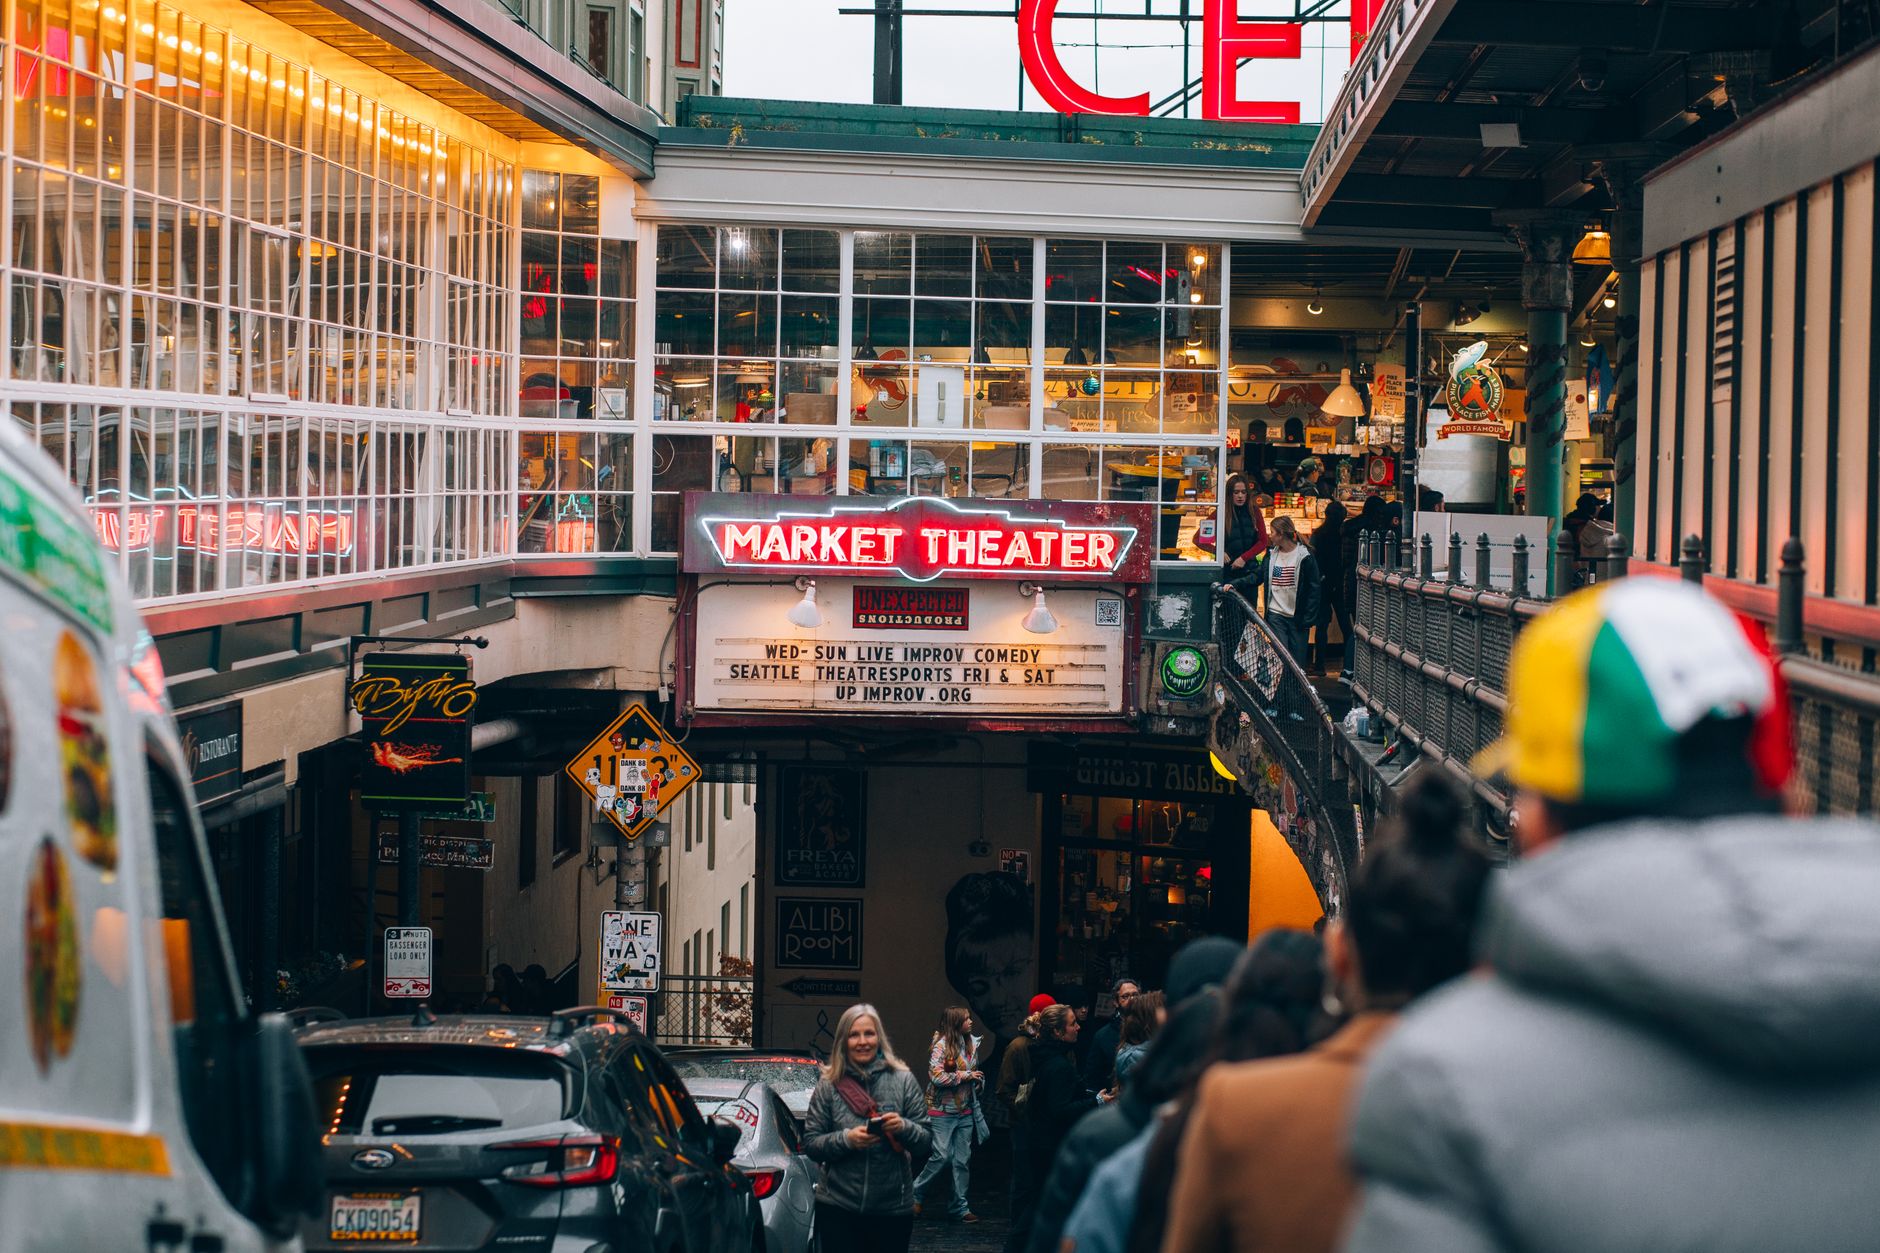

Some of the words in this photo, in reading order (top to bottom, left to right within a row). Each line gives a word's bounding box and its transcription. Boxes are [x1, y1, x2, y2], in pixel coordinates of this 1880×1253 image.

[1017, 0, 1385, 121] CE
[1453, 403, 1473, 419] PLACE
[1475, 408, 1492, 418] FISH
[1490, 378, 1501, 409] MARKET
[1473, 424, 1504, 432] FAMOUS
[724, 524, 903, 563] MARKET
[920, 527, 1115, 569] THEATER
[858, 590, 964, 612] UNEXPECTED
[858, 614, 963, 625] PRODUCTIONS
[815, 646, 847, 662] SUN
[857, 647, 894, 662] LIVE
[903, 647, 964, 663] IMPROV
[974, 648, 1040, 664] COMEDY
[729, 663, 800, 681] SEATTLE
[816, 666, 953, 683] THEATRESPORTS
[963, 667, 990, 683] FRI
[999, 668, 1009, 683] &
[1023, 669, 1055, 684] SAT
[835, 686, 859, 701] UP
[349, 672, 477, 736] Bistro
[199, 733, 238, 763] RISTORANTE
[1077, 757, 1156, 788] GHOST
[787, 849, 856, 863] FREYA
[1002, 850, 1015, 860] NO
[814, 863, 856, 872] BAKERY
[788, 906, 852, 932] ALIBI
[389, 941, 427, 950] PASSENGER
[389, 951, 407, 960] LOAD
[409, 951, 426, 960] ONLY
